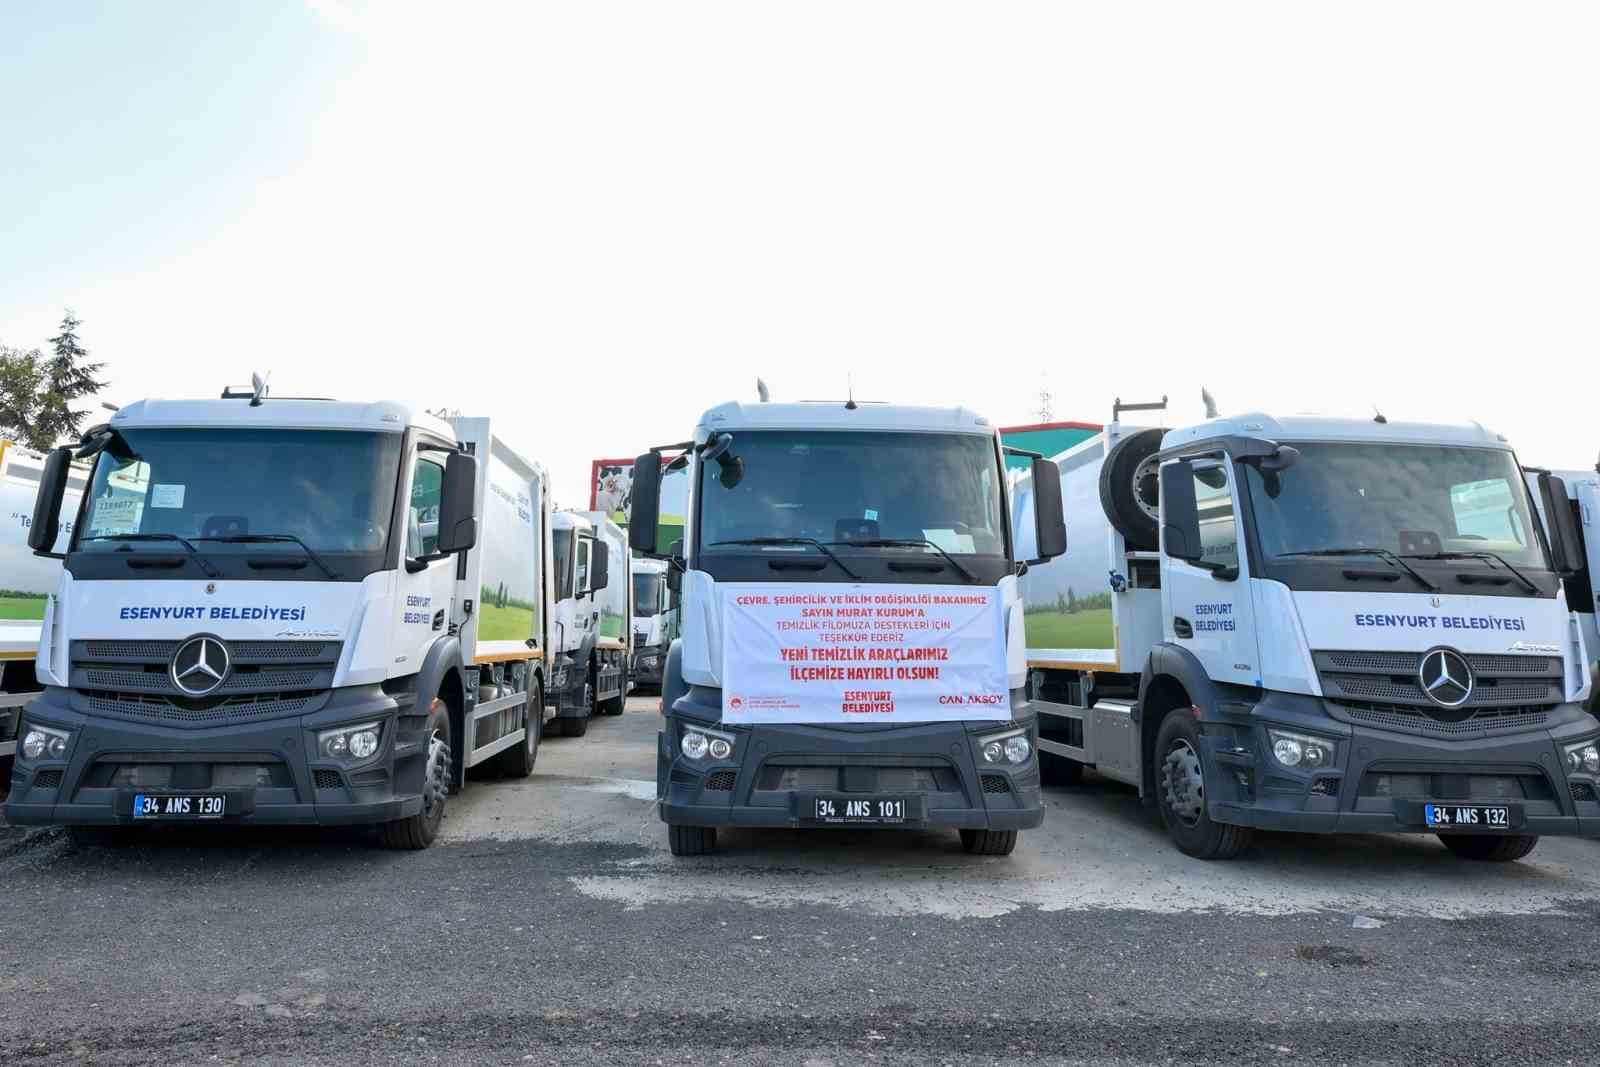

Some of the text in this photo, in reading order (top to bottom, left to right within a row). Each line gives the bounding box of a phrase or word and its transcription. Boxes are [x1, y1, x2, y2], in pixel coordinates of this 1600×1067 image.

[830, 595, 844, 604] VE
[845, 593, 872, 604] İKLİM
[933, 596, 987, 604] BAKANIMIZ
[120, 605, 305, 621] ESENYURT BELEDİYESİ
[802, 608, 925, 617] SAYIN MURAT KURUM'A
[1196, 603, 1233, 615] ESENYURT
[776, 620, 819, 630] TEMİZLİK
[874, 620, 929, 630] DESTEKLERİ
[1355, 614, 1526, 631] ESENYURT BELEDİYESİ
[871, 632, 904, 642] EDERİZ
[780, 646, 948, 664] YENİ TEMİZLİK ARAÇLARIMIZ
[790, 664, 939, 683] İLÇEMİZE HAYIRLI OLSUN!
[844, 691, 892, 701] ESENYURT
[939, 695, 1003, 705] CAN AKSOY
[842, 702, 894, 713] BELEDİYESİ
[143, 798, 221, 813] 34 ANS 130
[819, 800, 901, 817] 34 ANS 101
[1434, 807, 1506, 824] 34 ANS 132
